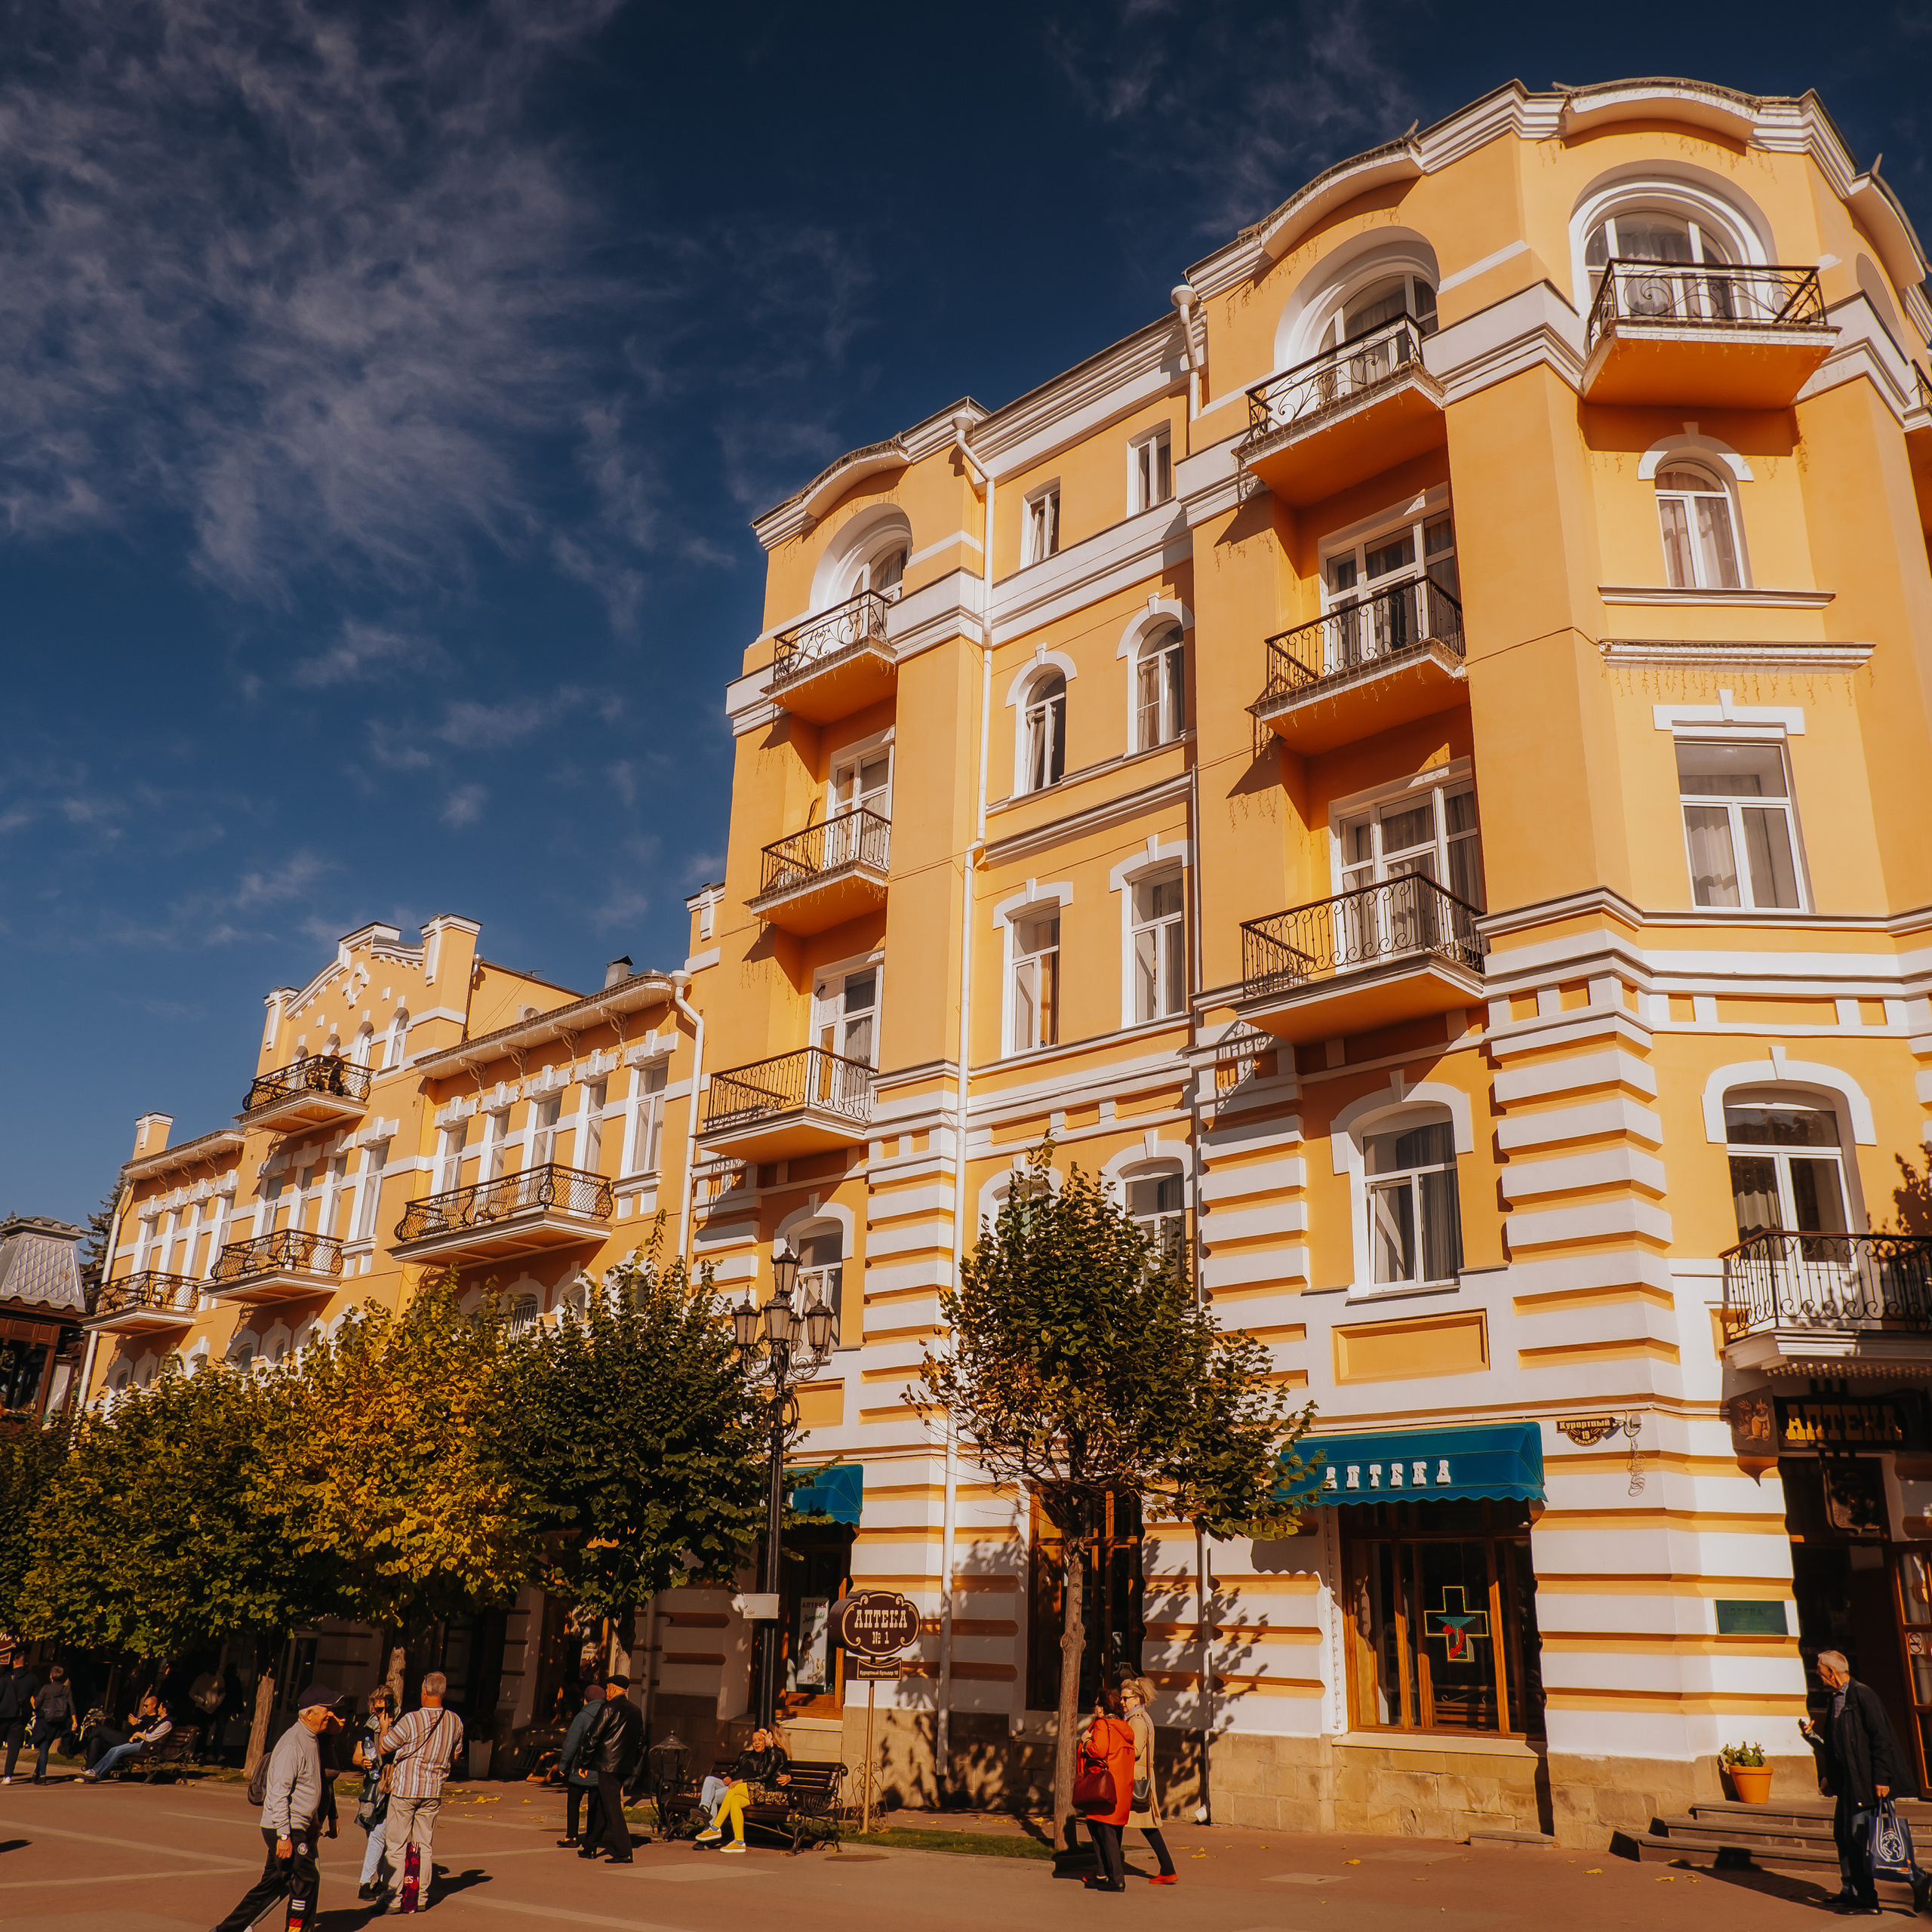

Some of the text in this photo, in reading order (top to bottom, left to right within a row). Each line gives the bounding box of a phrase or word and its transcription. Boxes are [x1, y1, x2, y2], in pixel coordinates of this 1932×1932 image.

[1559, 1419, 1611, 1429] Курортный
[1785, 1404, 1903, 1441] АПТЕКА
[1582, 1430, 1590, 1439] 19
[1323, 1460, 1451, 1491] АПТЕКА
[854, 1610, 907, 1628] АПТЕКА
[872, 1632, 890, 1644] № 1
